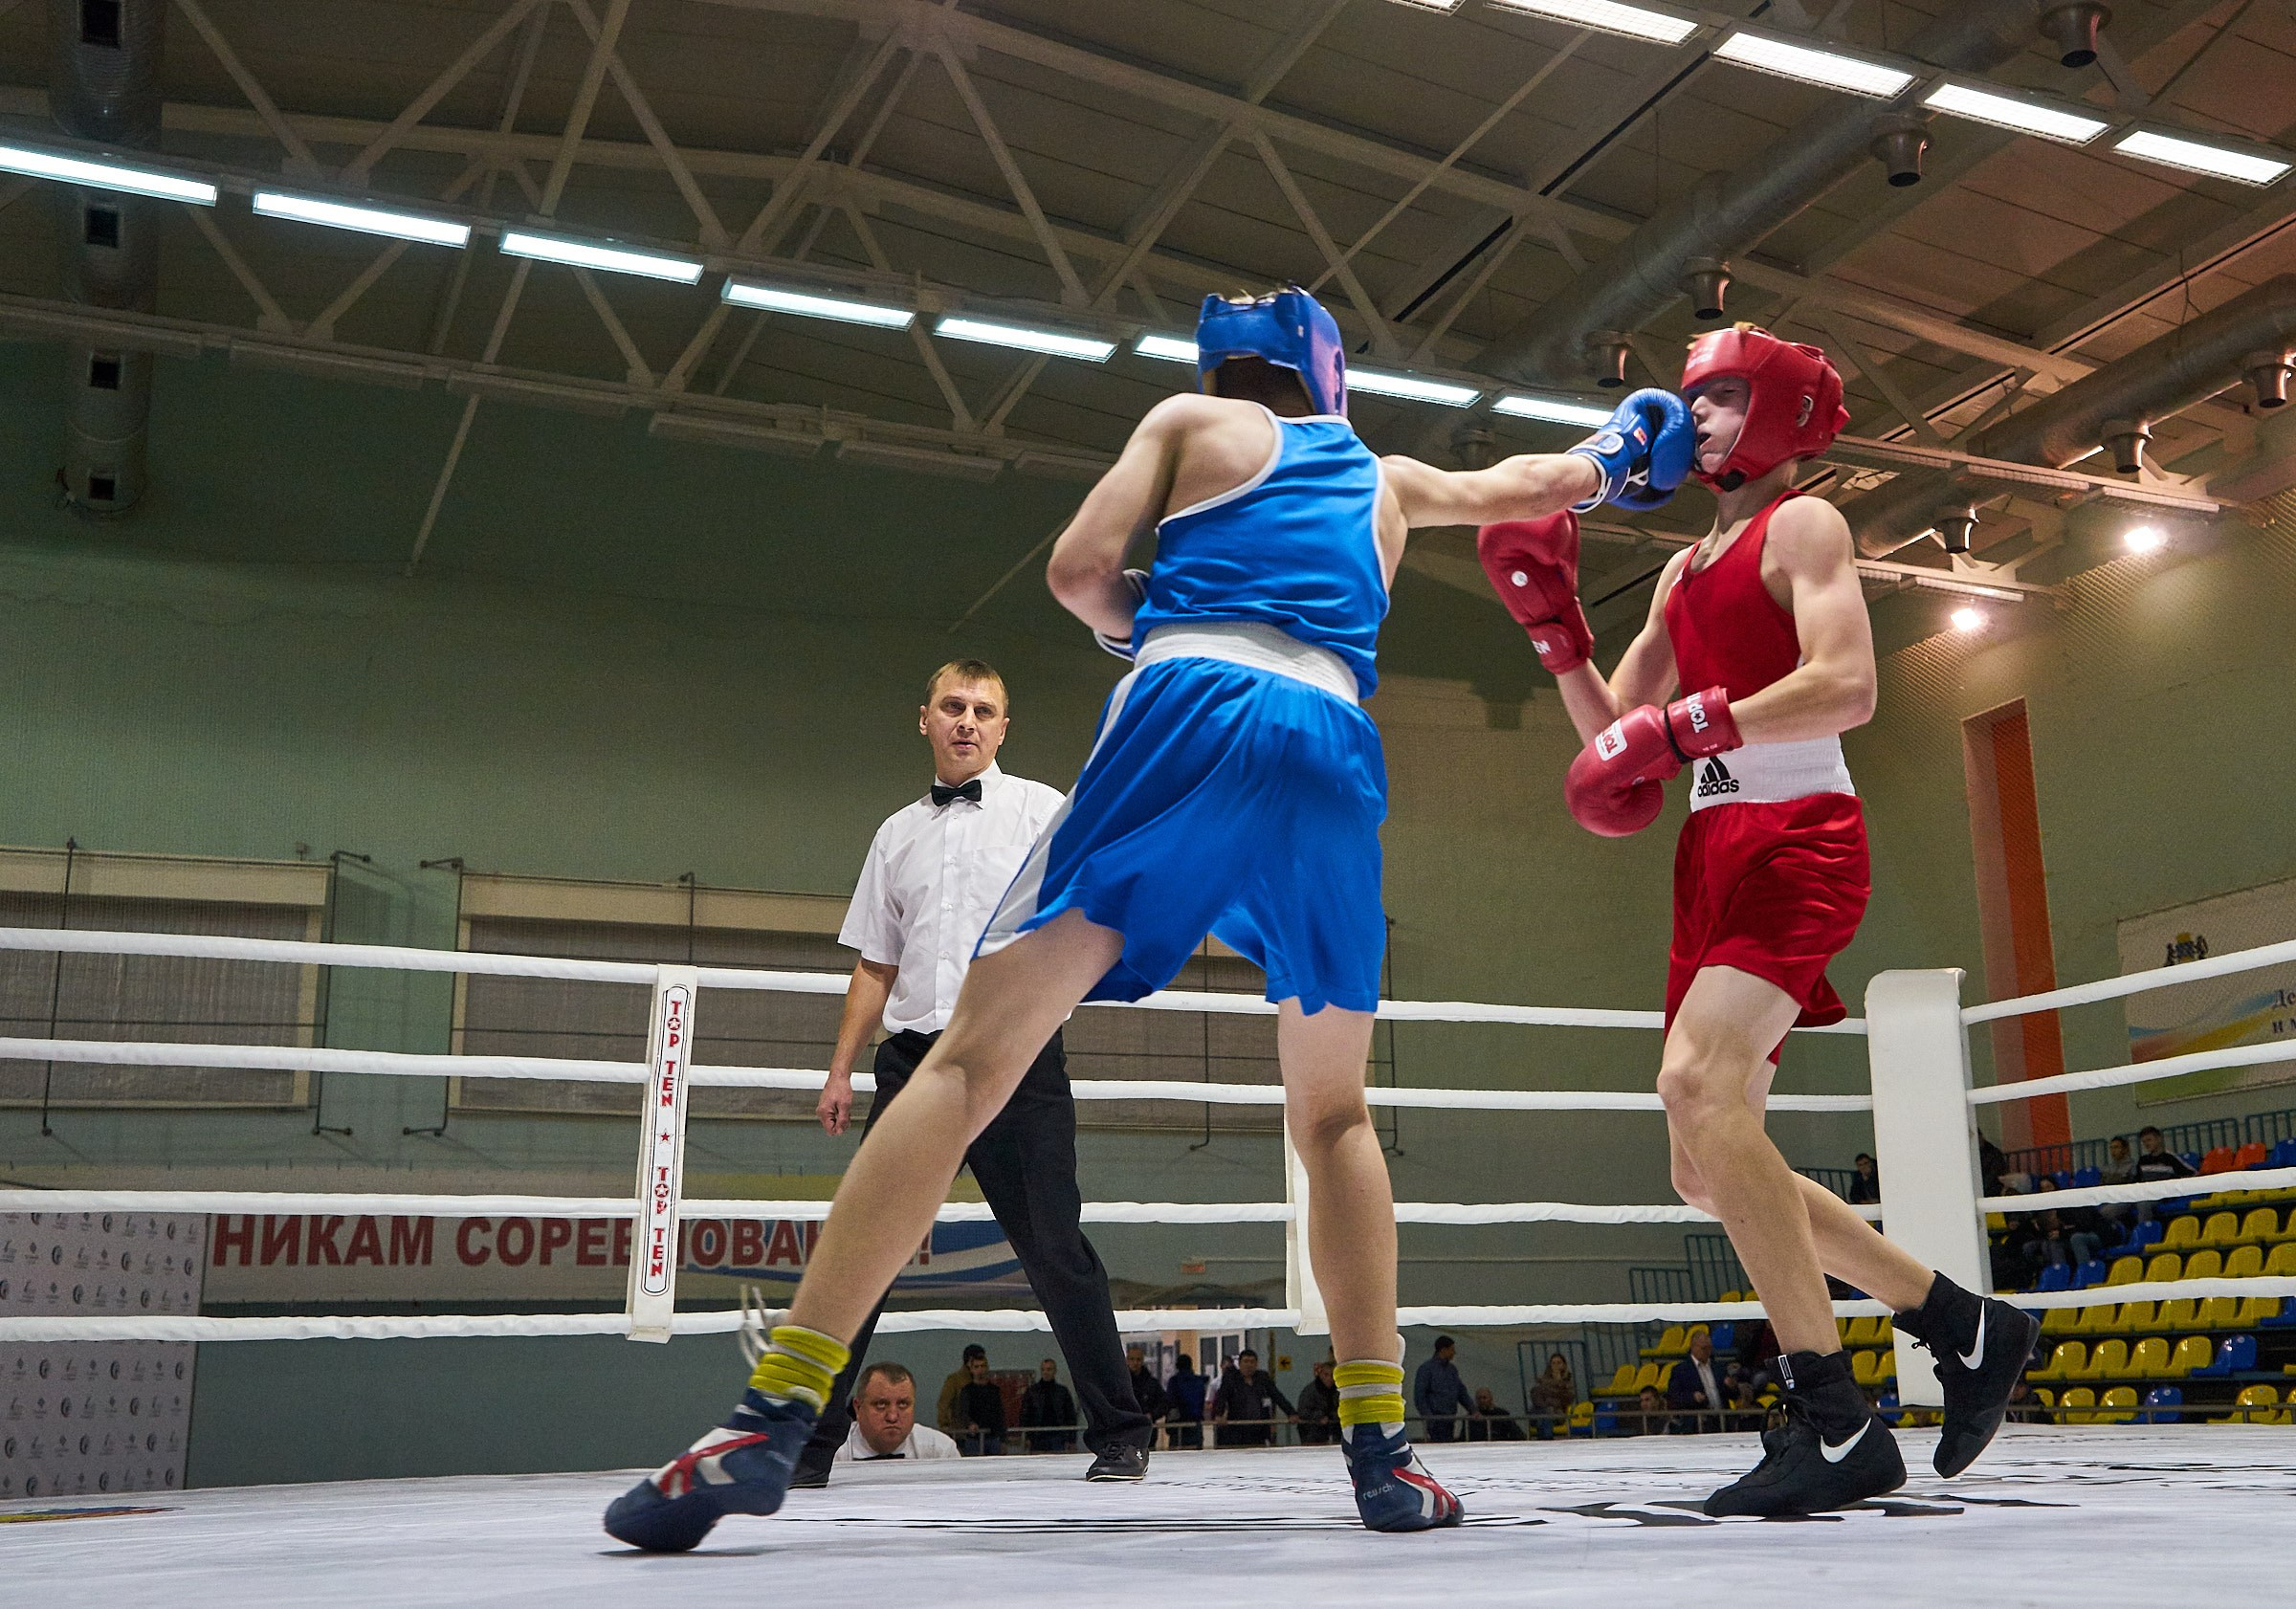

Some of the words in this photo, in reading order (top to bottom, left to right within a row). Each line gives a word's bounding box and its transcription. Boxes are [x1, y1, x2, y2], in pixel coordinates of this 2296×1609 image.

[1697, 779, 1740, 798] adidas
[668, 1000, 682, 1047] TOP
[661, 1060, 676, 1107] TEN
[654, 1166, 670, 1215] TOP
[651, 1227, 665, 1277] TEN
